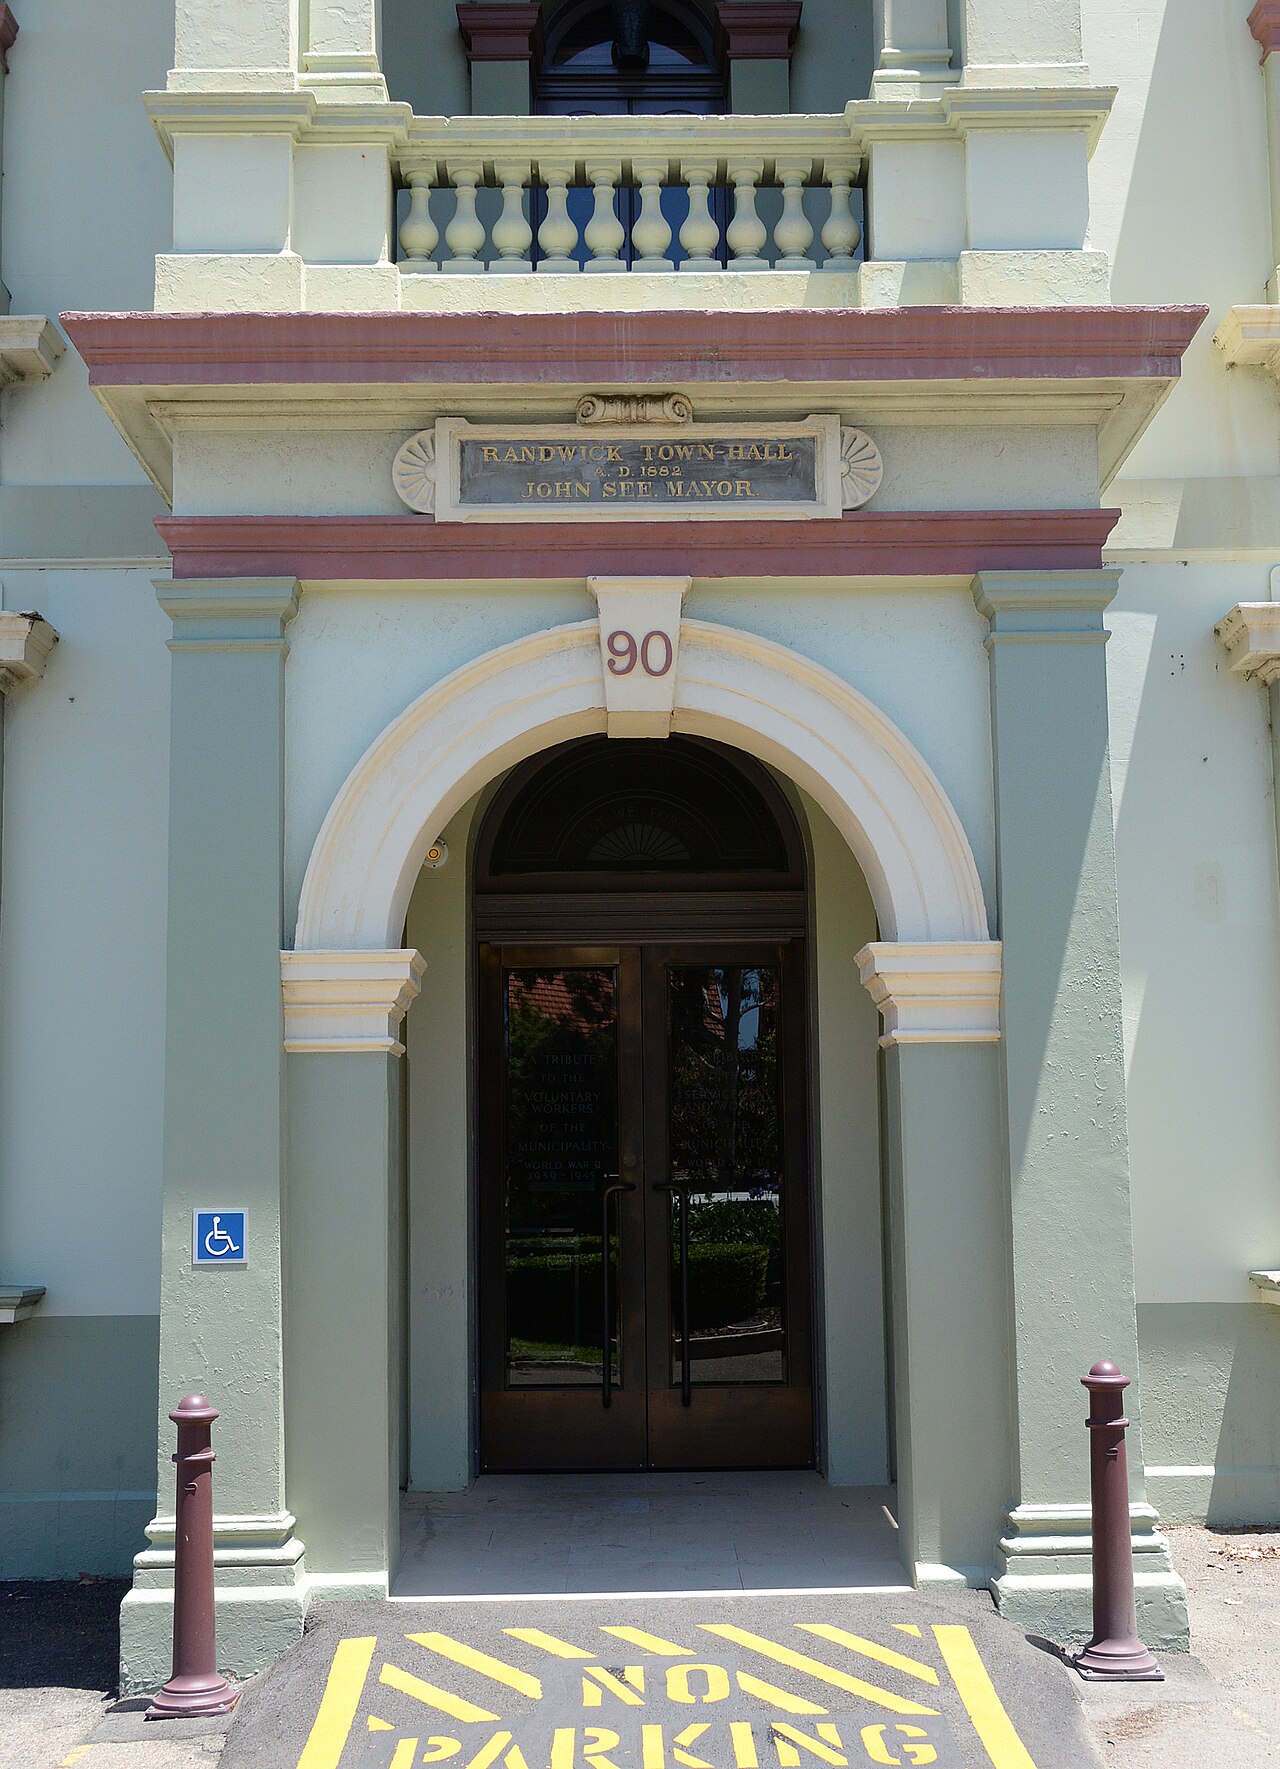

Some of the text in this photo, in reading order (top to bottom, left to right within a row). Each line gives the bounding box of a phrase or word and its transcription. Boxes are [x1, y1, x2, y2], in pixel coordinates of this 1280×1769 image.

[481, 443, 793, 463] RANDWICK TOWN-HALL
[640, 465, 683, 477] 1882
[520, 482, 591, 499] JOHN
[666, 480, 760, 498] MAYOR.
[607, 630, 673, 677] 90
[544, 1055, 596, 1065] TRIBUTE
[541, 1073, 586, 1083] TO THE
[524, 1091, 602, 1103] VOLUNTARY
[531, 1103, 594, 1114] WORKERS
[539, 1122, 586, 1132] OF THE
[518, 1141, 608, 1152] MUNICIPALITY
[524, 1160, 562, 1170] WORLD
[567, 1160, 591, 1169] WAR
[582, 1663, 731, 1707] NO
[388, 1722, 938, 1769] PARKING
